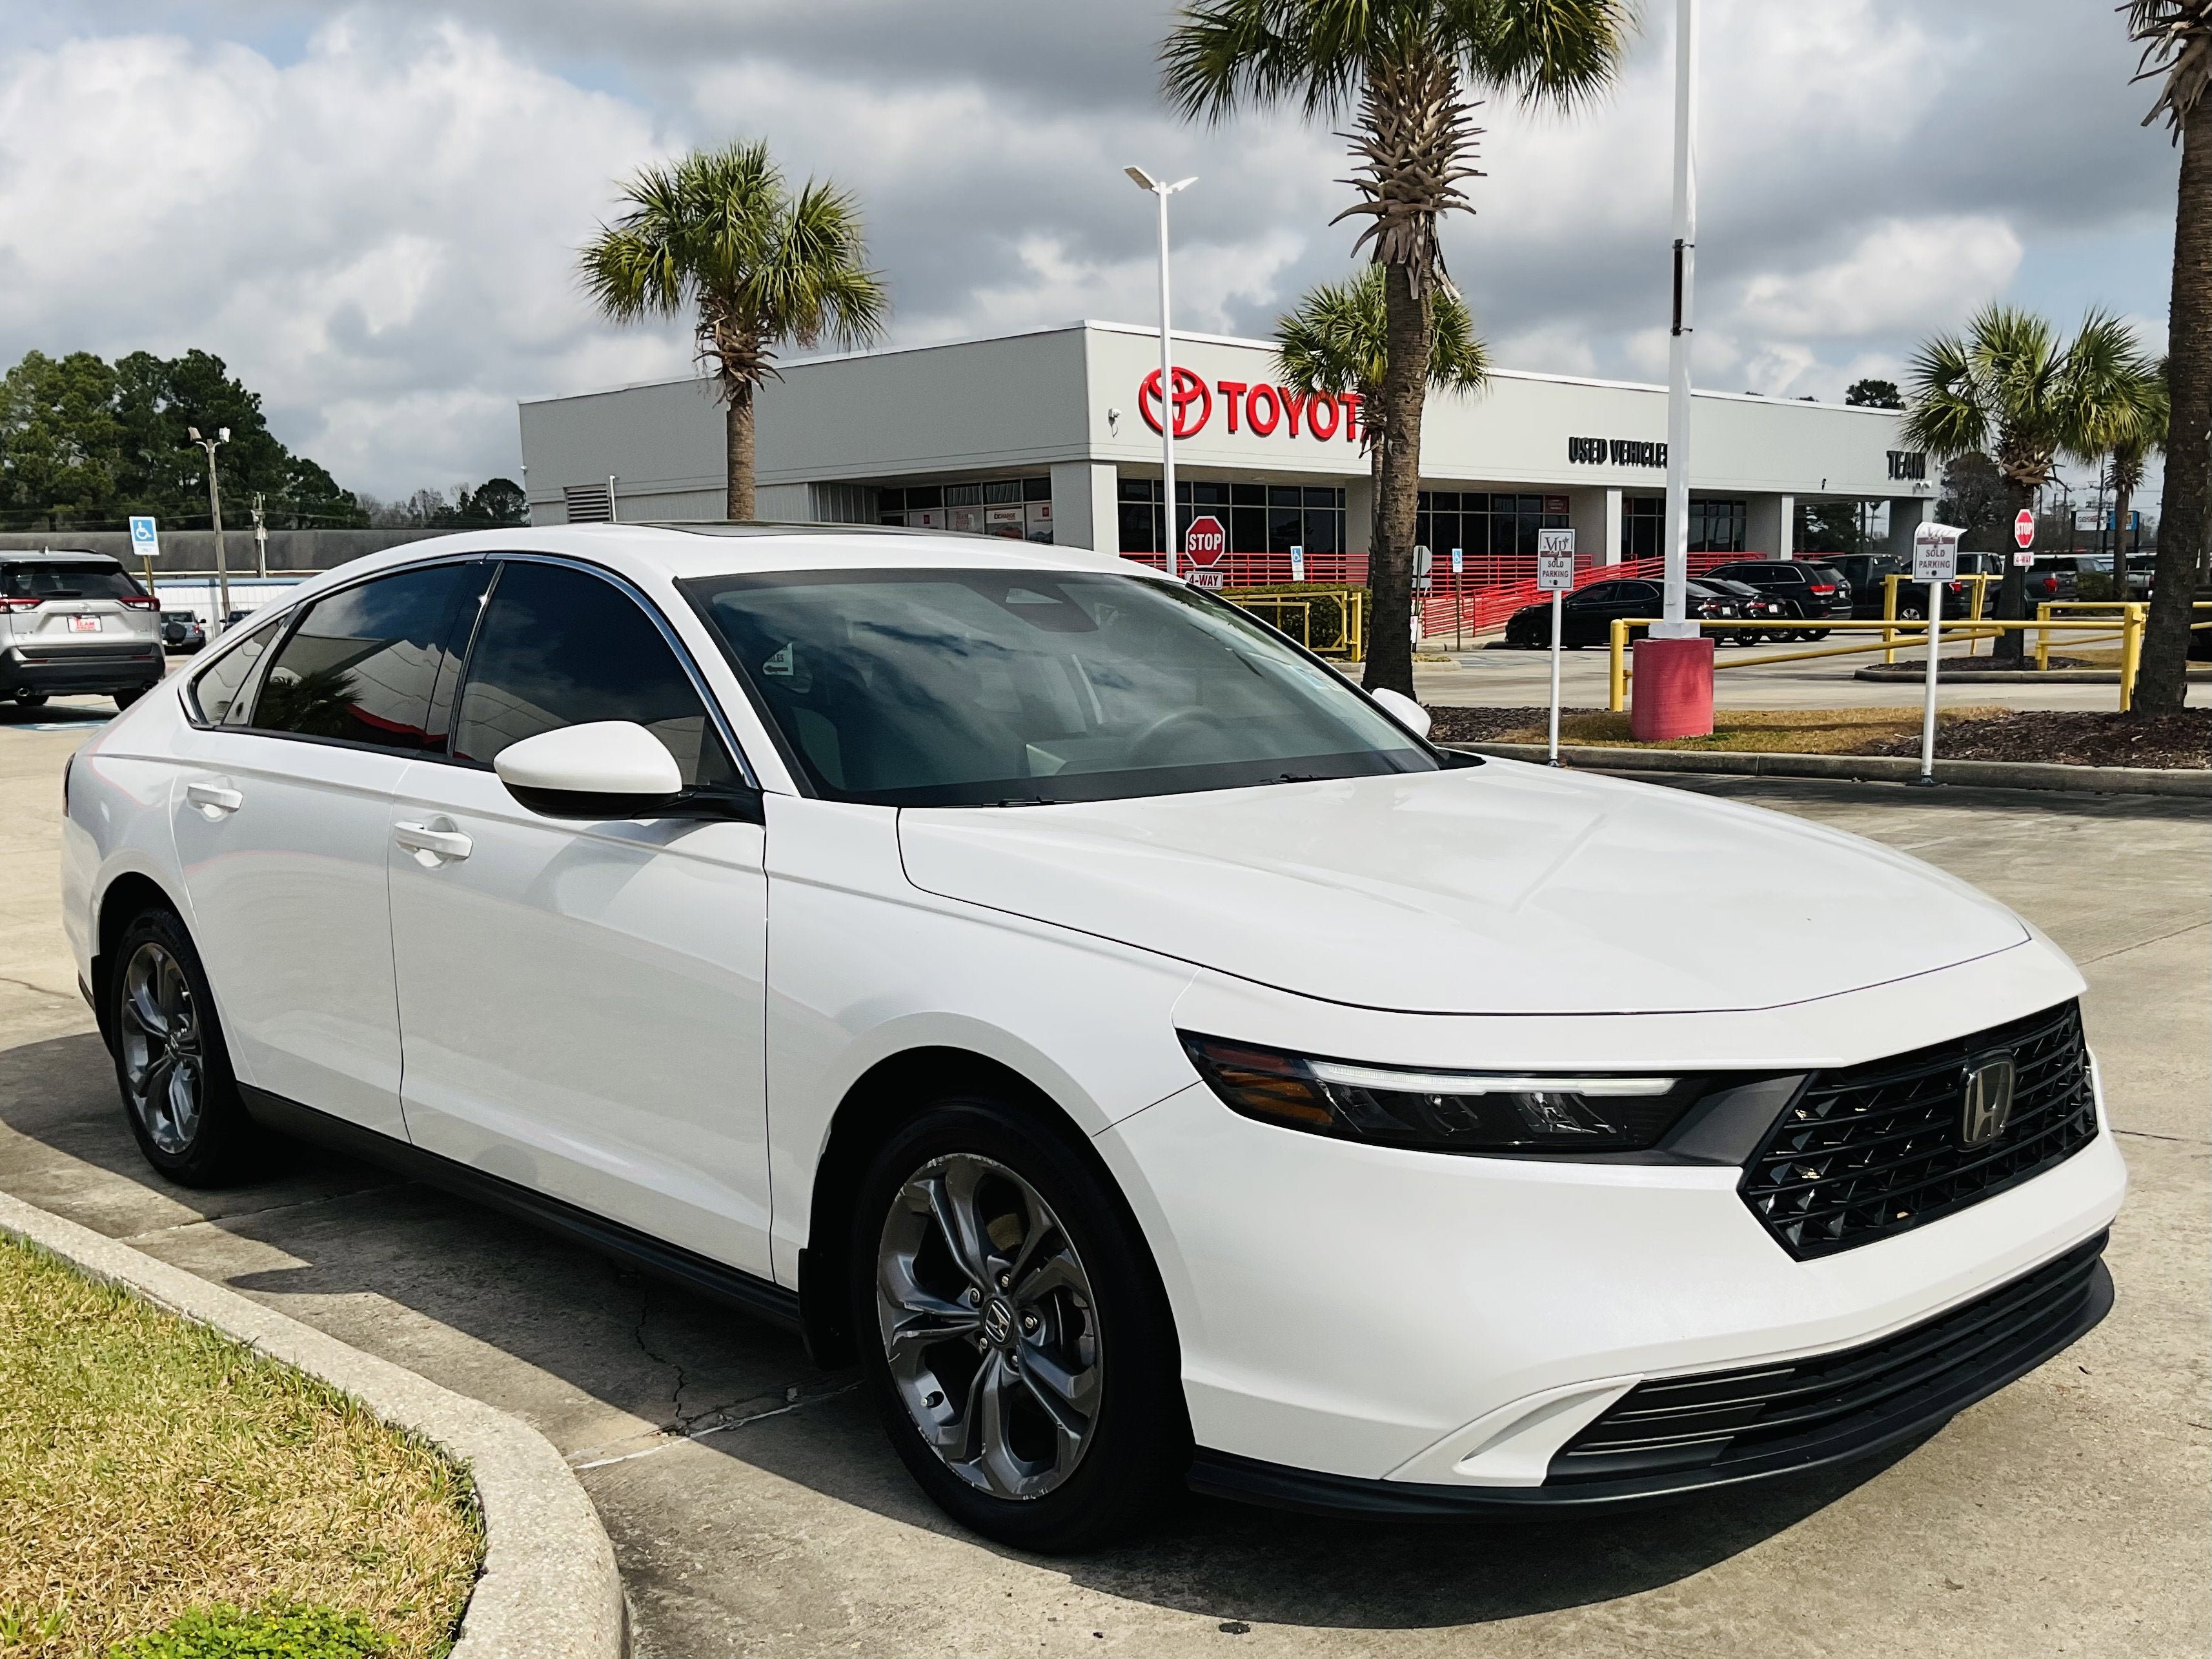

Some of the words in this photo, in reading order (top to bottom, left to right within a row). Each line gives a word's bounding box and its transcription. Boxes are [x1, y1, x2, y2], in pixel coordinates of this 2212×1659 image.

[1217, 380, 1369, 443] TOYOT
[1568, 436, 1608, 465] USED
[1886, 451, 1926, 480] TEAM
[2016, 522, 2033, 535] STOP
[1188, 533, 1222, 551] STOP
[1918, 560, 1951, 569] PARKING
[2015, 555, 2032, 564] 4-WAY
[1188, 574, 1219, 587] 4-WAY
